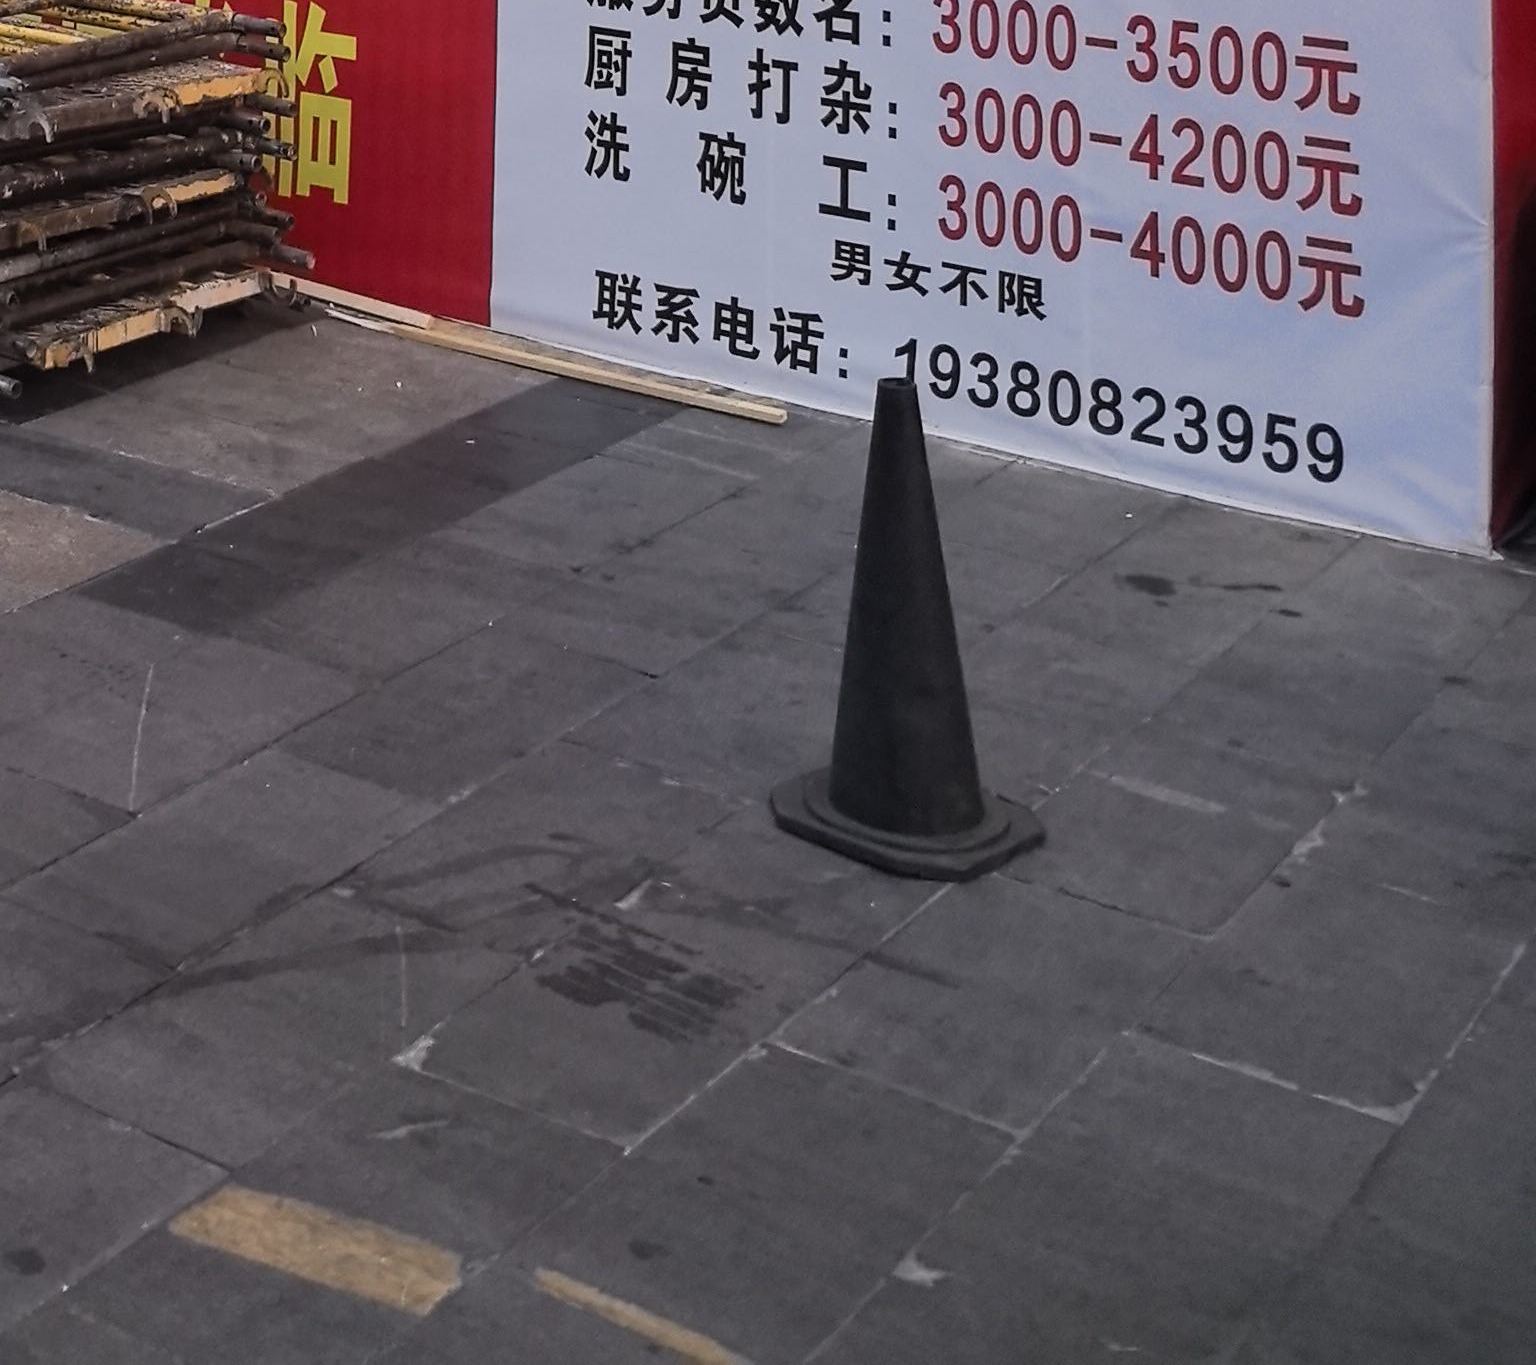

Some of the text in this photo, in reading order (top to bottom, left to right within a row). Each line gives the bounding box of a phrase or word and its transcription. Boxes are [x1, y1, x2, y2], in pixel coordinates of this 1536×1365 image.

[831, 239, 1047, 322] 男女不限
[894, 337, 1347, 483] 19380823959
